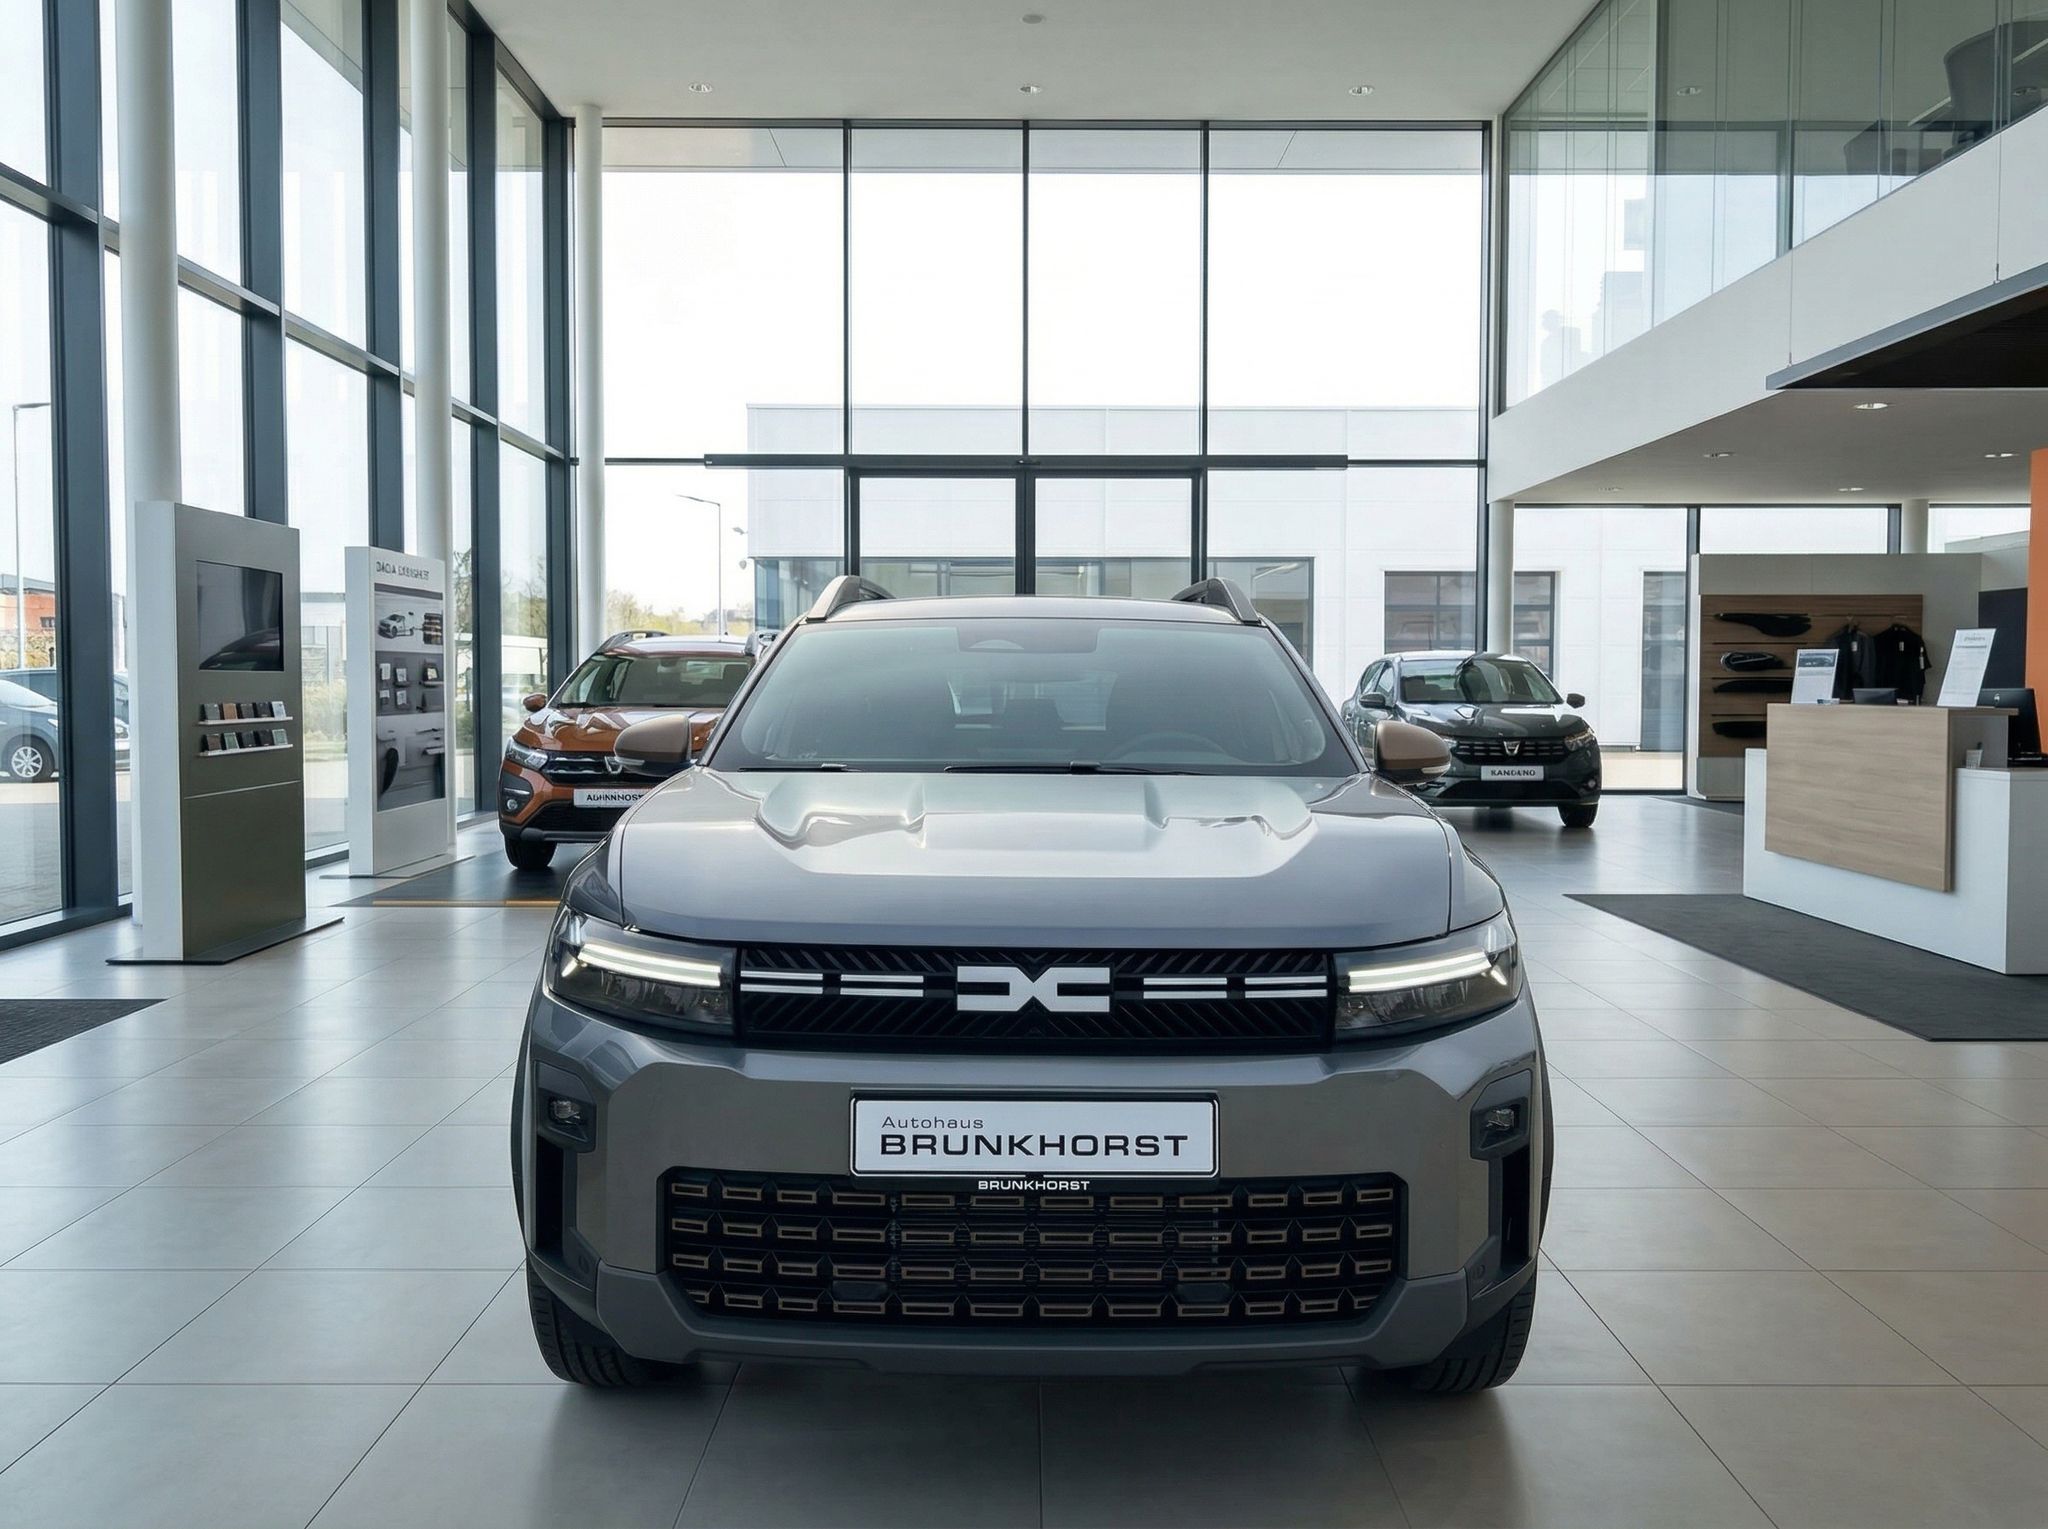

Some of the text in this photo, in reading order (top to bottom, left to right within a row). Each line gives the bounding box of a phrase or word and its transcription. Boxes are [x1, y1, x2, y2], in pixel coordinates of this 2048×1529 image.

[881, 1115, 984, 1129] Autohaus
[880, 1134, 1188, 1156] BRUNKHORST
[978, 1180, 1090, 1190] BRUNKHORST
